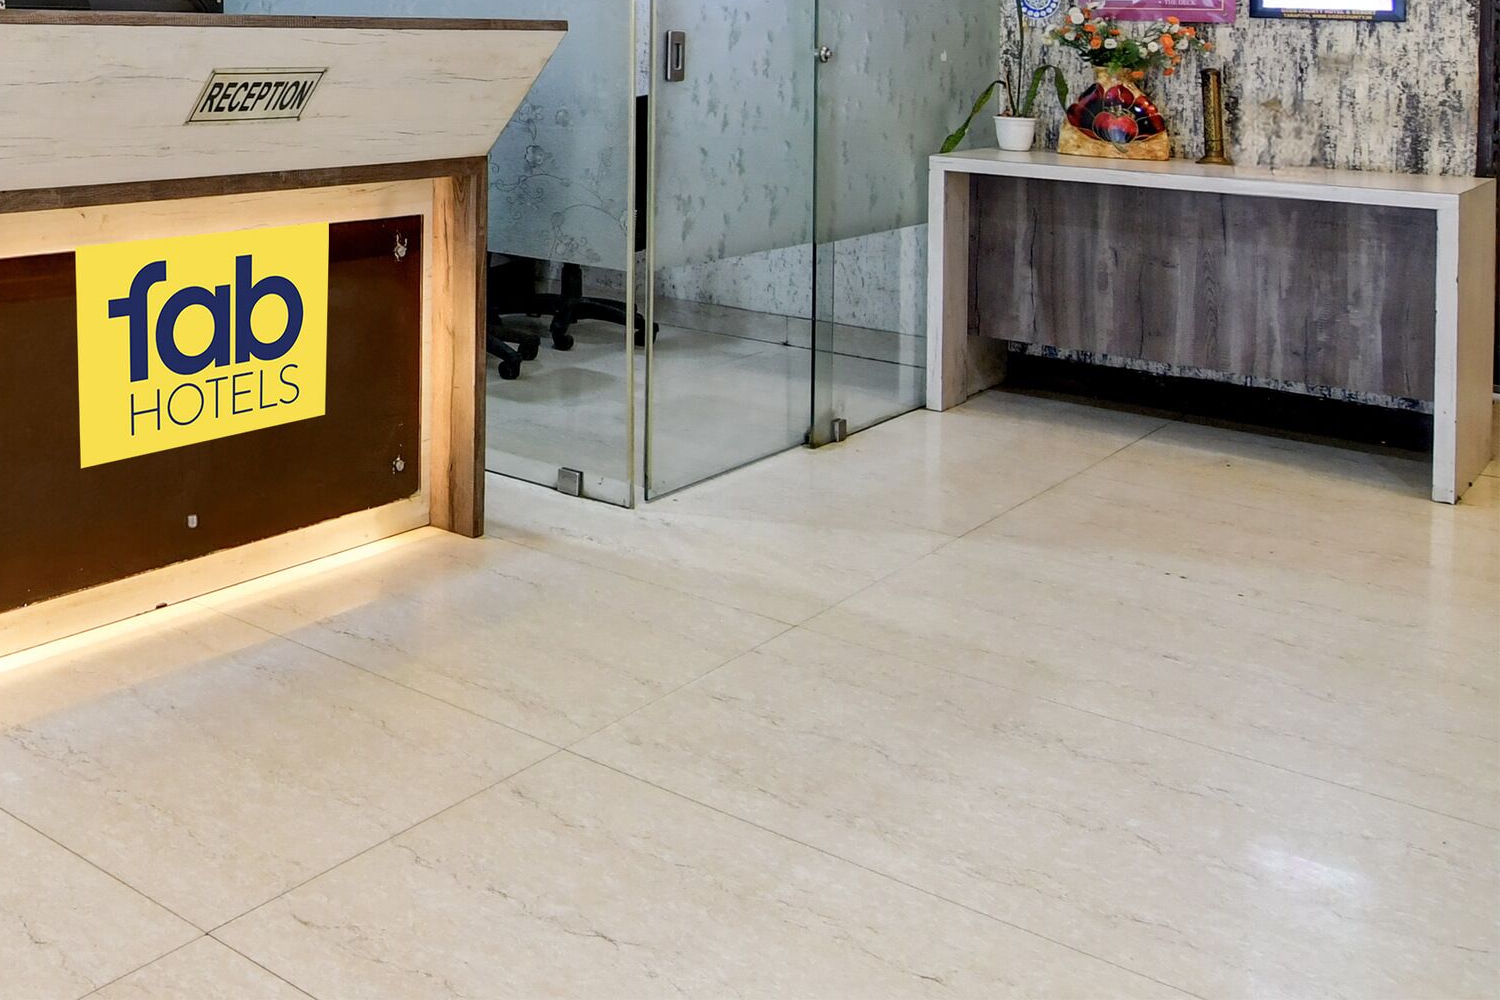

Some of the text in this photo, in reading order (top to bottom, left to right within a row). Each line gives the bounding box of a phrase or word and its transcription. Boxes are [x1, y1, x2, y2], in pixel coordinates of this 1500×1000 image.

[199, 80, 315, 113] RECEPTION
[108, 254, 304, 383] fab
[130, 363, 300, 436] HOTELS
